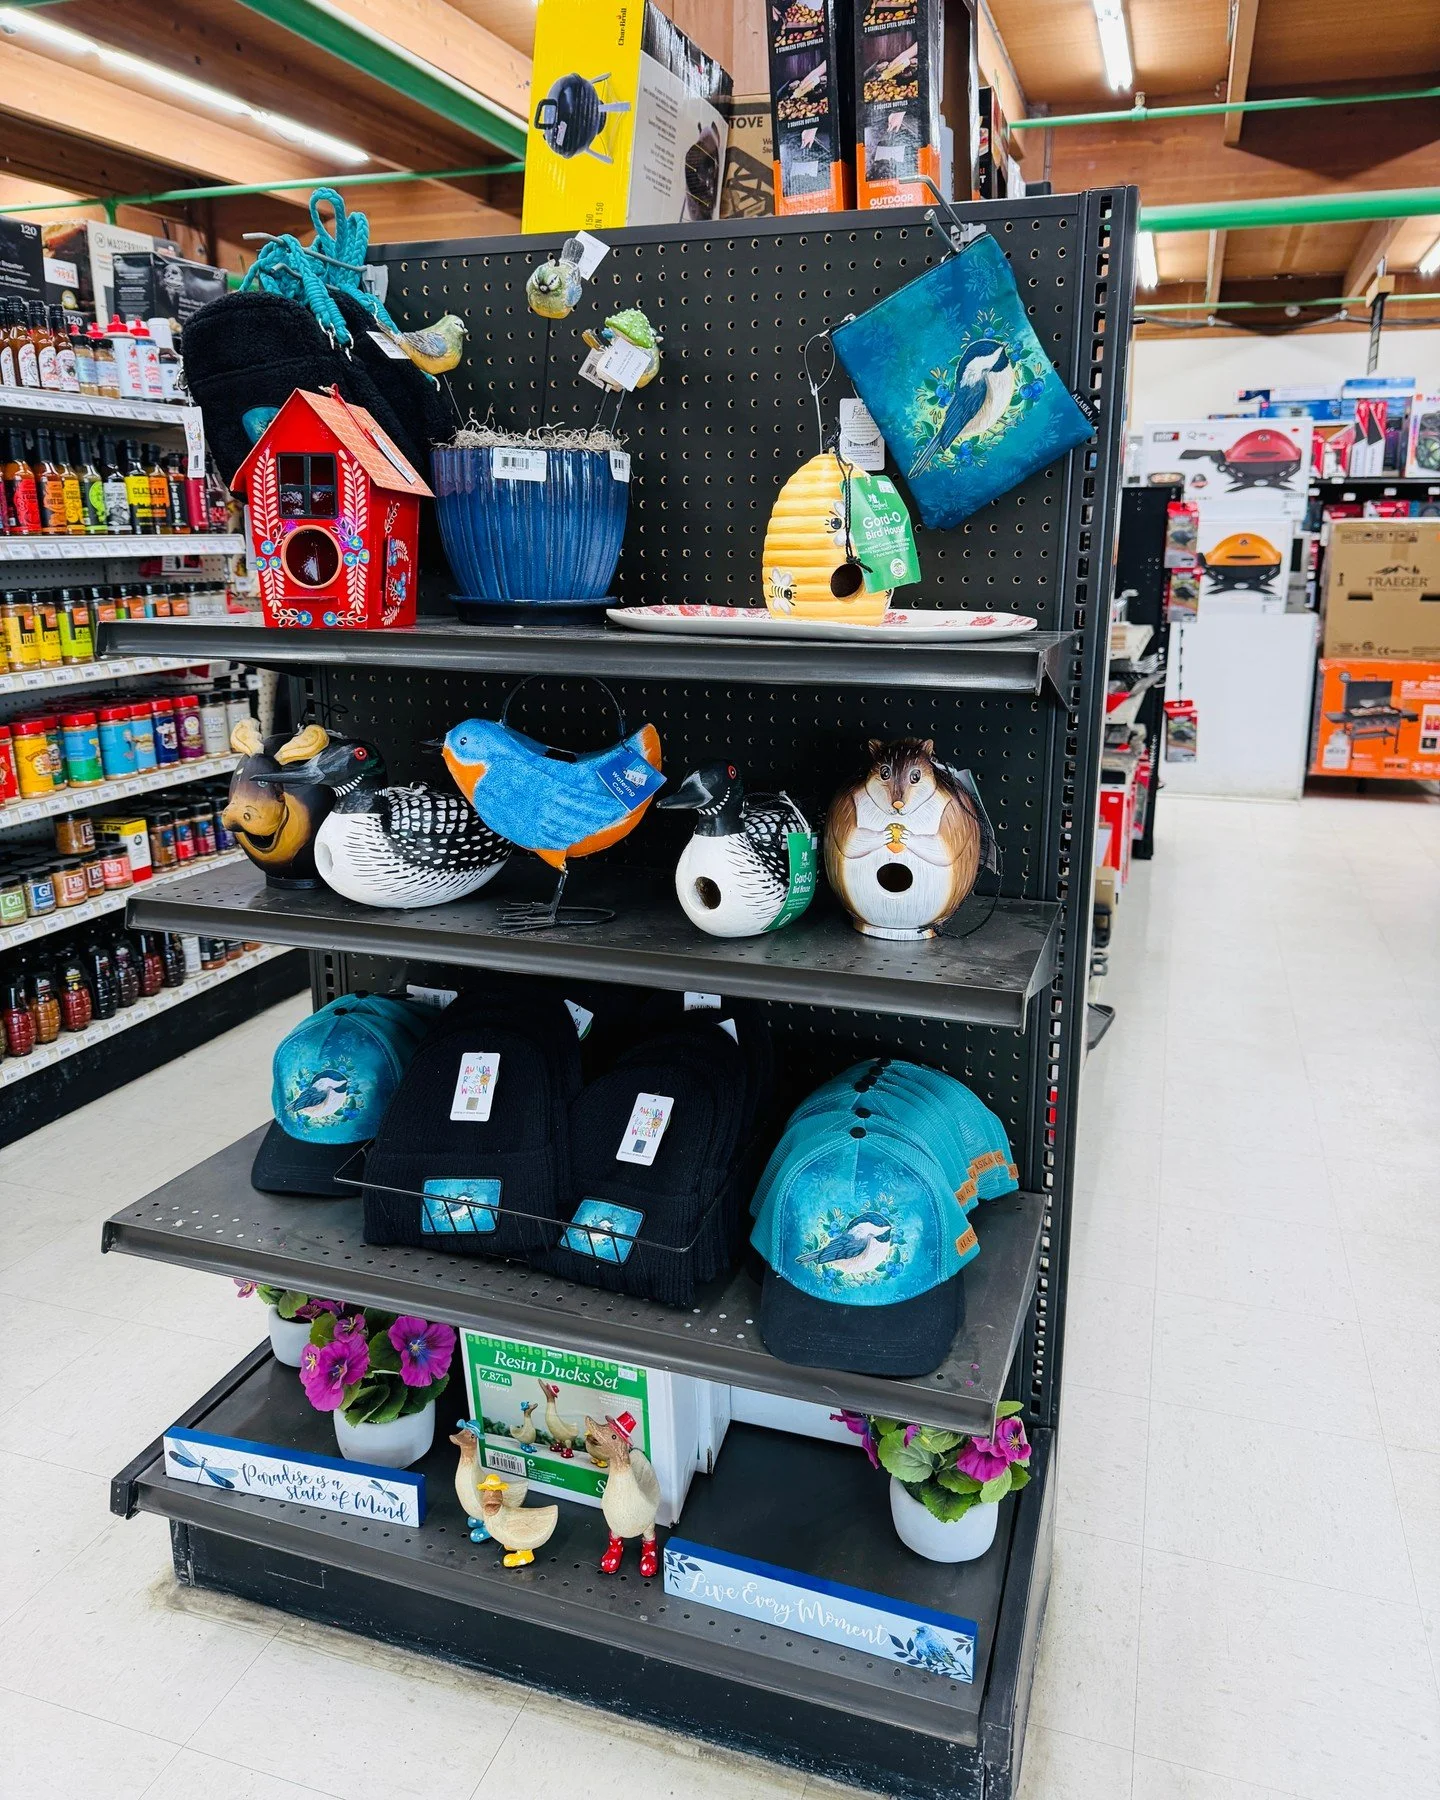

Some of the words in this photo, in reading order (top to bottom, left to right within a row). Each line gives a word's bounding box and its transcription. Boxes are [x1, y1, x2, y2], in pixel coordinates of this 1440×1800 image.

[870, 194, 914, 205] OUTDOOR
[20, 224, 37, 237] 120
[67, 315, 83, 326] 120
[1072, 393, 1093, 417] ALASKA
[863, 510, 901, 528] Gord-O
[866, 526, 883, 541] Bird
[884, 523, 906, 538] House
[1367, 577, 1428, 588] TRAEGER
[612, 771, 636, 797] Watering
[612, 782, 624, 795] Can
[6, 895, 21, 907] Ch
[494, 1350, 536, 1372] Resin
[541, 1360, 590, 1383] Ducks
[593, 1371, 618, 1390] Set
[238, 1463, 313, 1487] Paradise
[316, 1474, 328, 1489] is
[331, 1480, 343, 1490] a
[286, 1483, 327, 1502] state
[331, 1492, 351, 1510] of
[351, 1492, 410, 1523] Mind
[684, 1568, 739, 1603] Live
[741, 1581, 794, 1625] Every
[791, 1597, 891, 1646] Moment
